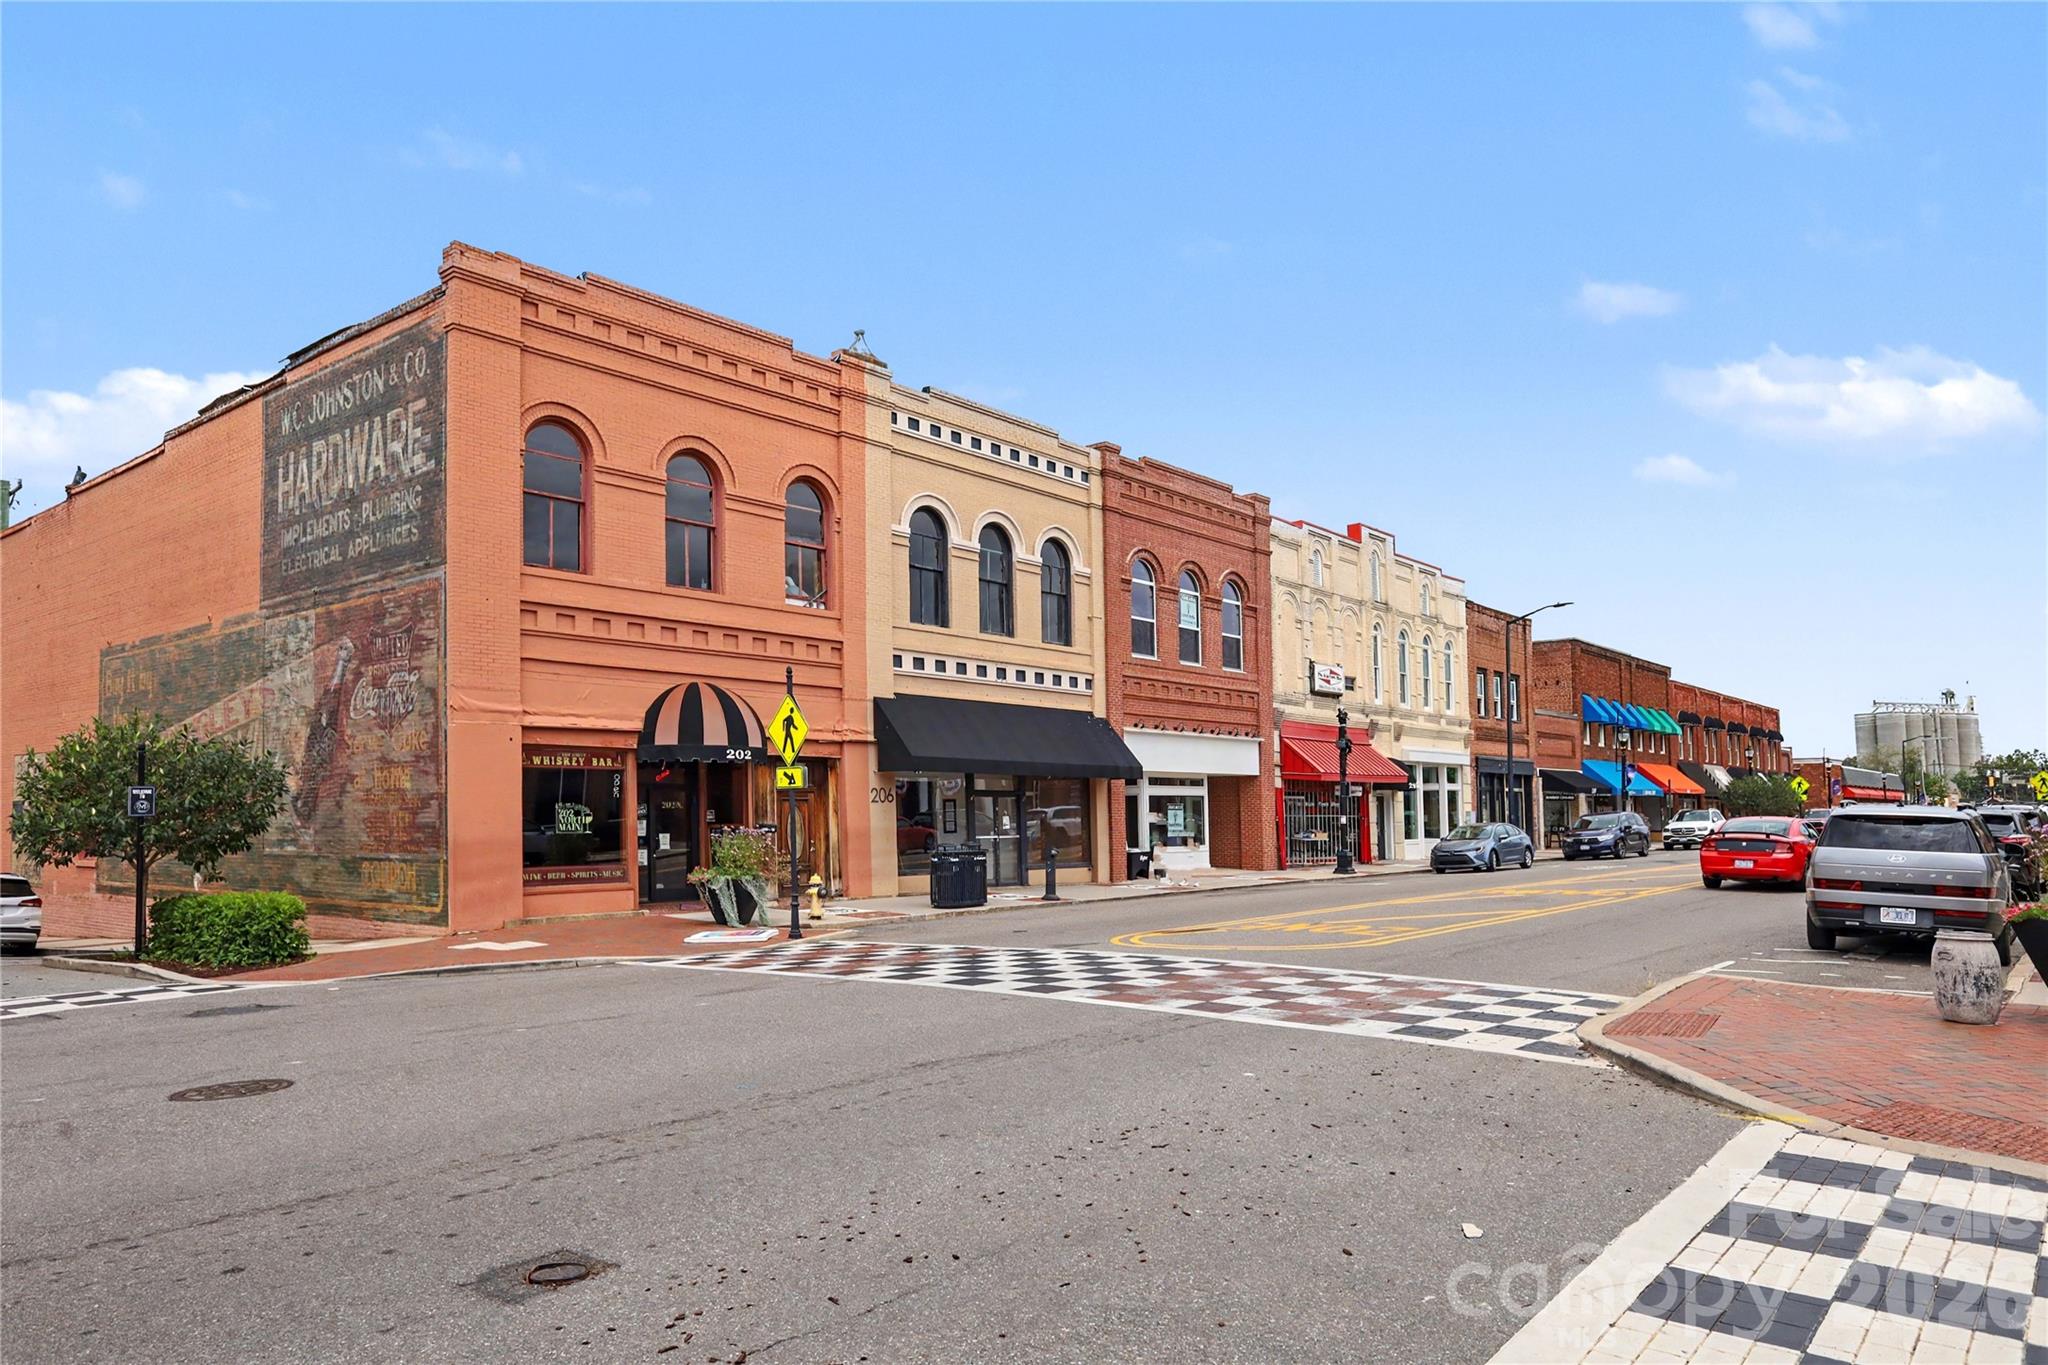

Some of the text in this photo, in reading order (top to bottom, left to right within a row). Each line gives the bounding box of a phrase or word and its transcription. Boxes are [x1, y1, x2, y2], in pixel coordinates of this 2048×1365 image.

[308, 366, 385, 424] JOHNSTON
[277, 400, 435, 515] HARDWARE
[281, 485, 422, 548] IMPLEMENTS PLUMBING
[281, 545, 343, 576] ELECTRICAL
[532, 755, 613, 767] WHISKEY BAR
[726, 749, 752, 760] 202
[870, 787, 895, 804] 206
[558, 823, 581, 831] MAIN
[547, 872, 566, 880] BEER
[571, 870, 598, 880] SPIRITS
[602, 869, 624, 877] MUSIC
